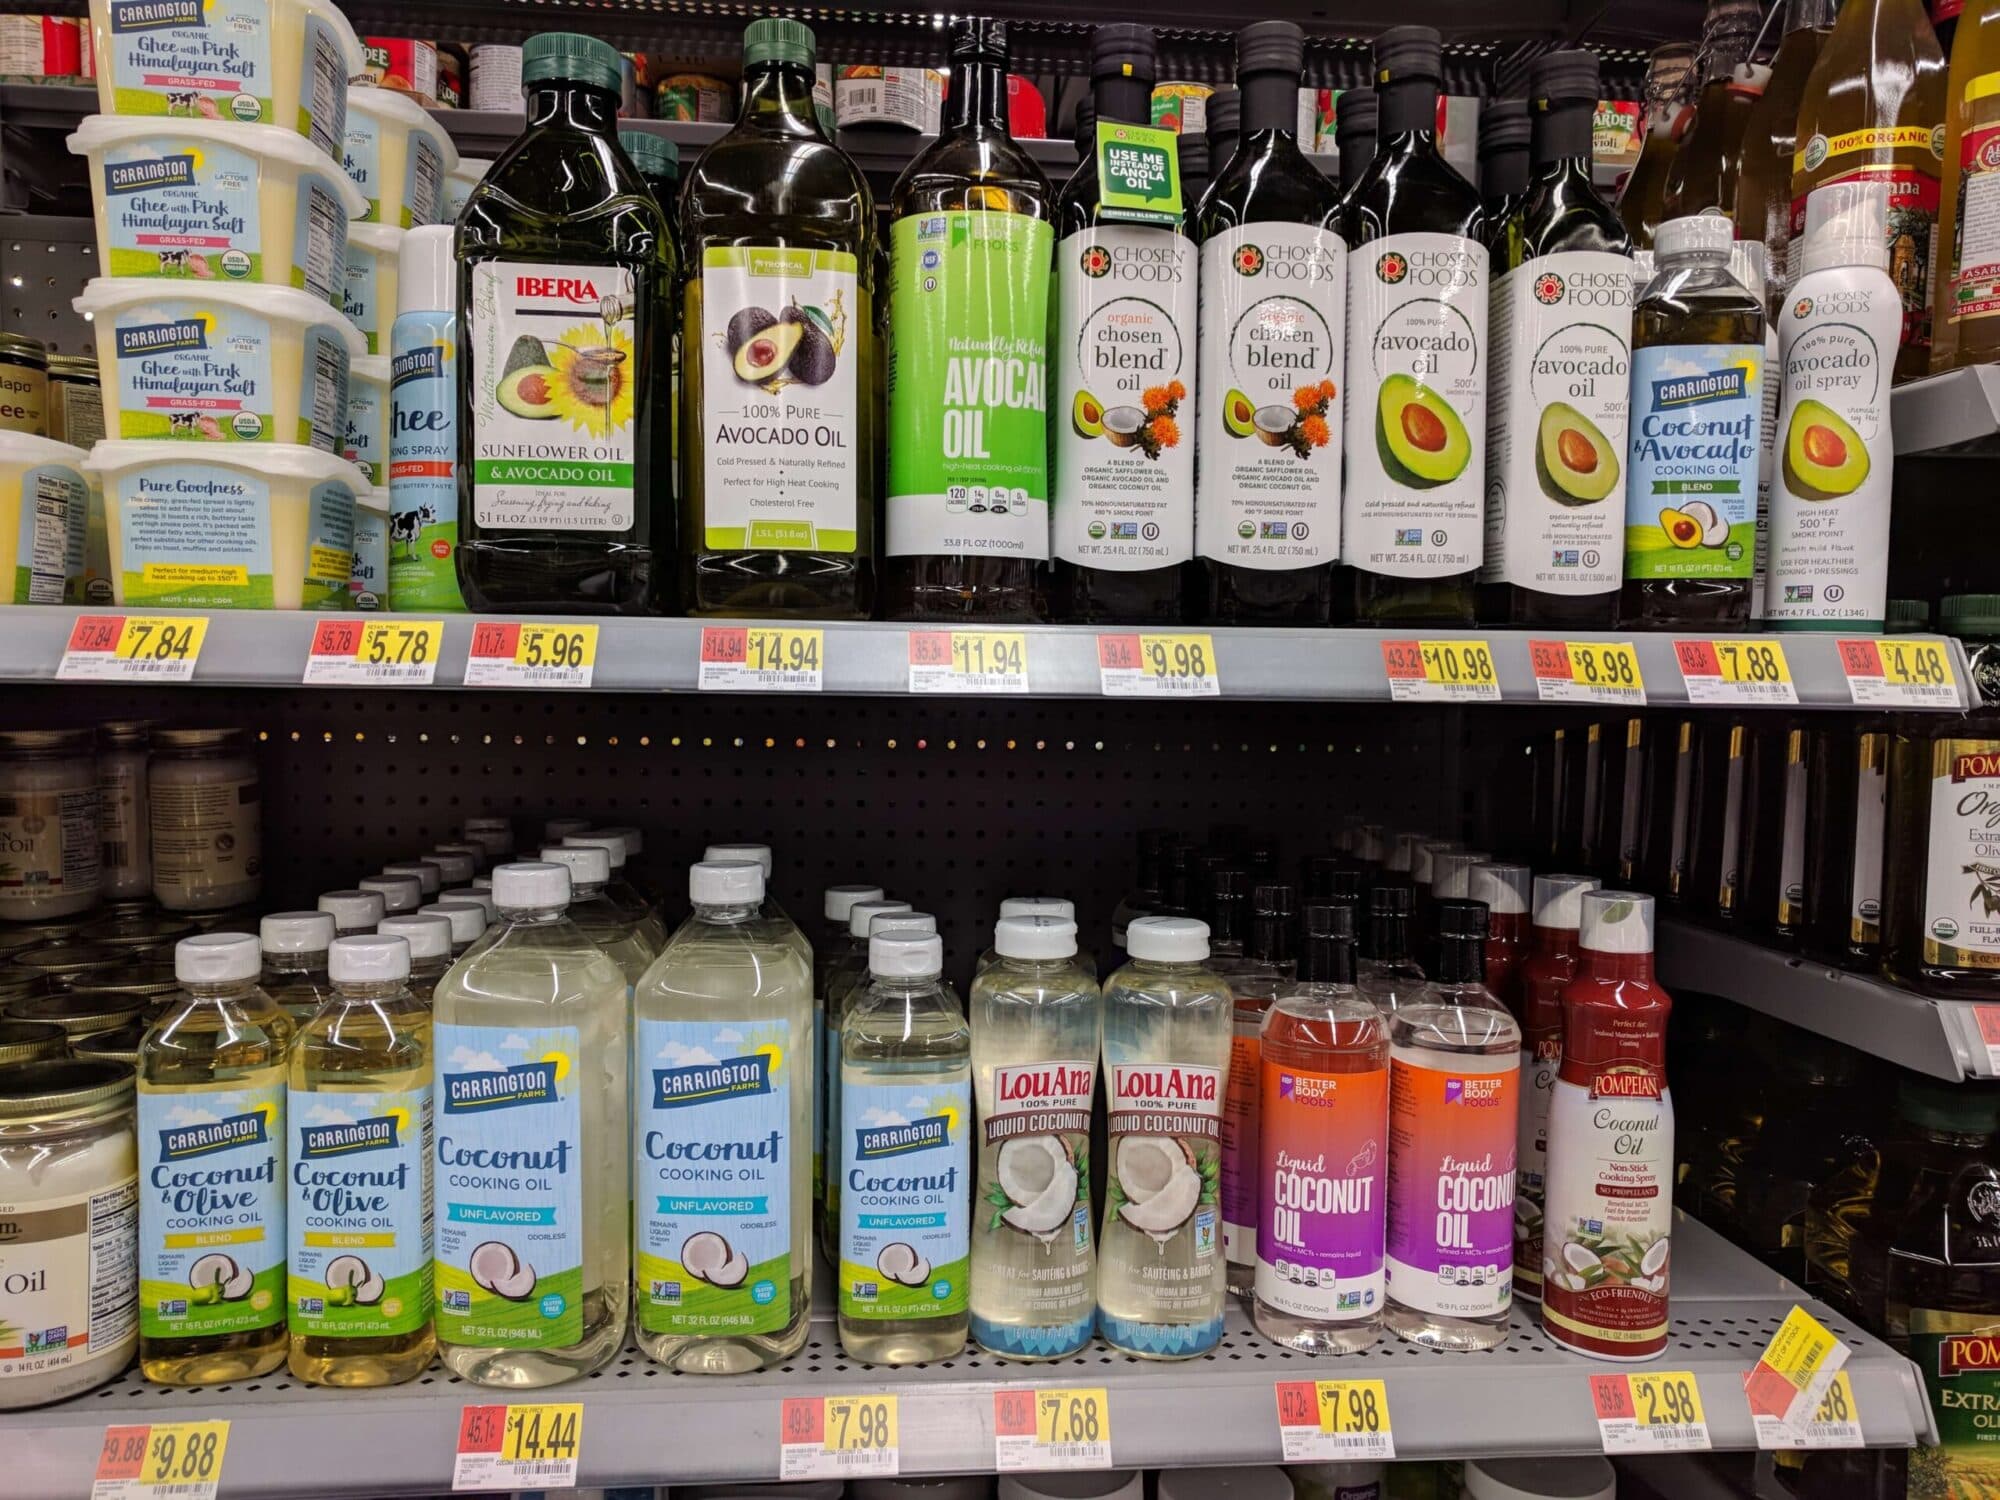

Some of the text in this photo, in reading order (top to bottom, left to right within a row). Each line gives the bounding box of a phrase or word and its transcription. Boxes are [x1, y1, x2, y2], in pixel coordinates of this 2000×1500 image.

[1833, 131, 1928, 150] 100% ORGANIC
[1110, 149, 1164, 165] USE ME
[1110, 160, 1150, 171] INSTEAD
[112, 161, 187, 184] CARRINGTON
[1111, 167, 1166, 182] CANOLA
[1126, 178, 1152, 190] OIL
[130, 197, 229, 217] Ghee with Pink
[121, 213, 245, 235] Himalayan Salt
[160, 237, 206, 245] GRASS-FED
[1113, 247, 1183, 264] CHOSEN
[1113, 263, 1182, 283] FOODS
[1266, 261, 1333, 281] FOODS
[1409, 268, 1477, 288] FOODS
[517, 277, 599, 304] IBERIA
[1568, 289, 1633, 307] FOODS
[1816, 290, 1872, 303] CHOSEN
[1816, 301, 1870, 316] FOODS
[1108, 314, 1153, 326] organic
[123, 325, 199, 347] CARRINGTON
[1098, 325, 1163, 343] chosen
[1380, 330, 1470, 352] avocado
[1802, 335, 1855, 351] 100% pure
[949, 336, 1015, 361] Naturally
[1095, 346, 1164, 370] blend
[1246, 344, 1316, 369] blend
[1559, 345, 1608, 354] 100% PURE
[1538, 355, 1627, 376] avocado
[1789, 349, 1870, 375] avocado
[1117, 374, 1140, 390] oil
[1268, 374, 1292, 390] oil
[1569, 378, 1595, 397] oil
[1660, 374, 1739, 400] CARRINGTON
[1795, 374, 1862, 391] oil spray
[742, 405, 781, 418] 100%
[943, 409, 991, 459] OIL
[1642, 414, 1755, 440] Coconut
[411, 446, 448, 455] SPRAY
[481, 444, 625, 461] SUNFLOWER OIL
[1640, 437, 1755, 464] Avocado
[716, 457, 735, 465] Cold
[736, 457, 767, 465] Pressed
[779, 458, 815, 469] Naturally
[817, 459, 846, 469] Refined
[1655, 465, 1739, 475] COOKING OIL
[490, 467, 616, 482] & AVOCADO OIL
[723, 478, 839, 490] Perfect for High Heat Cooking
[139, 478, 245, 496] Pure Goodness
[1681, 483, 1713, 491] BLEND
[749, 499, 815, 508] Cholesterol Free
[1797, 509, 1816, 517] HIGH
[944, 539, 1024, 550] 33.8 FL OZ (1000ml)
[1791, 531, 1816, 539] SMOKE
[127, 625, 191, 660] $7.84
[366, 630, 429, 664] $5.78
[522, 633, 584, 667] $5.96
[748, 635, 818, 671] $14.94
[952, 640, 1022, 674] $11.94
[1146, 643, 1206, 678] $9.98
[1424, 647, 1492, 681] $10.98
[1573, 650, 1634, 684] $8.98
[1721, 647, 1779, 681] $7.88
[1886, 647, 1944, 684] $4.48
[451, 1070, 547, 1100] CARRINGTON
[661, 1063, 761, 1094] CARRINGTON
[731, 1082, 760, 1091] FARMS
[1000, 1066, 1092, 1101] LouAna
[1116, 1068, 1217, 1101] LouAna
[1295, 1077, 1337, 1090] BETTER
[1464, 1079, 1502, 1089] BETTER
[1594, 1075, 1658, 1095] POMPEIAN
[1295, 1086, 1326, 1098] BODY
[1464, 1089, 1494, 1099] BODY
[1134, 1099, 1198, 1110] 100% PURE
[988, 1114, 1083, 1139] LIQUID COCONUT
[1144, 1115, 1219, 1138] COCONUT OIL
[1593, 1108, 1659, 1132] Coconut
[168, 1118, 258, 1150] CARRINGTON
[863, 1122, 942, 1149] CARRINGTON
[645, 1131, 784, 1164] Coconut
[1614, 1134, 1643, 1155] Oil
[438, 1136, 572, 1174] Coconut
[1275, 1150, 1325, 1176] Liquid
[151, 1156, 278, 1189] Coconut
[659, 1168, 765, 1181] COOKING OIL
[1440, 1153, 1492, 1178] Liquid
[1610, 1163, 1648, 1172] Non-Stick
[294, 1162, 410, 1190] Coconut
[450, 1175, 552, 1190] COOKING OIL
[849, 1167, 959, 1193] Coconut
[1599, 1172, 1656, 1184] Cooking Spray
[173, 1187, 258, 1215] Olive
[860, 1194, 944, 1206] COOKING OIL
[1274, 1169, 1374, 1214] COCONUT
[313, 1188, 389, 1216] Olive
[670, 1200, 754, 1212] UNFLAVORED
[166, 1212, 263, 1229] COOKING OIL
[459, 1208, 541, 1222] UNFLAVORED
[869, 1216, 936, 1226] UNFLAVORED
[740, 1221, 777, 1230] ODORLESS
[1273, 1206, 1306, 1248] OIL
[1435, 1211, 1473, 1249] OIL
[196, 1233, 232, 1244] BLEND
[4, 1269, 47, 1295] Oil
[1590, 1289, 1652, 1303] ECO-FRIENDLY
[1322, 1390, 1379, 1432] $7.98
[1637, 1381, 1695, 1425] $2.98
[831, 1403, 888, 1449] $7.98
[1041, 1398, 1099, 1441] $7.68
[506, 1412, 577, 1459] $14.44
[151, 1430, 216, 1480] $9.88
